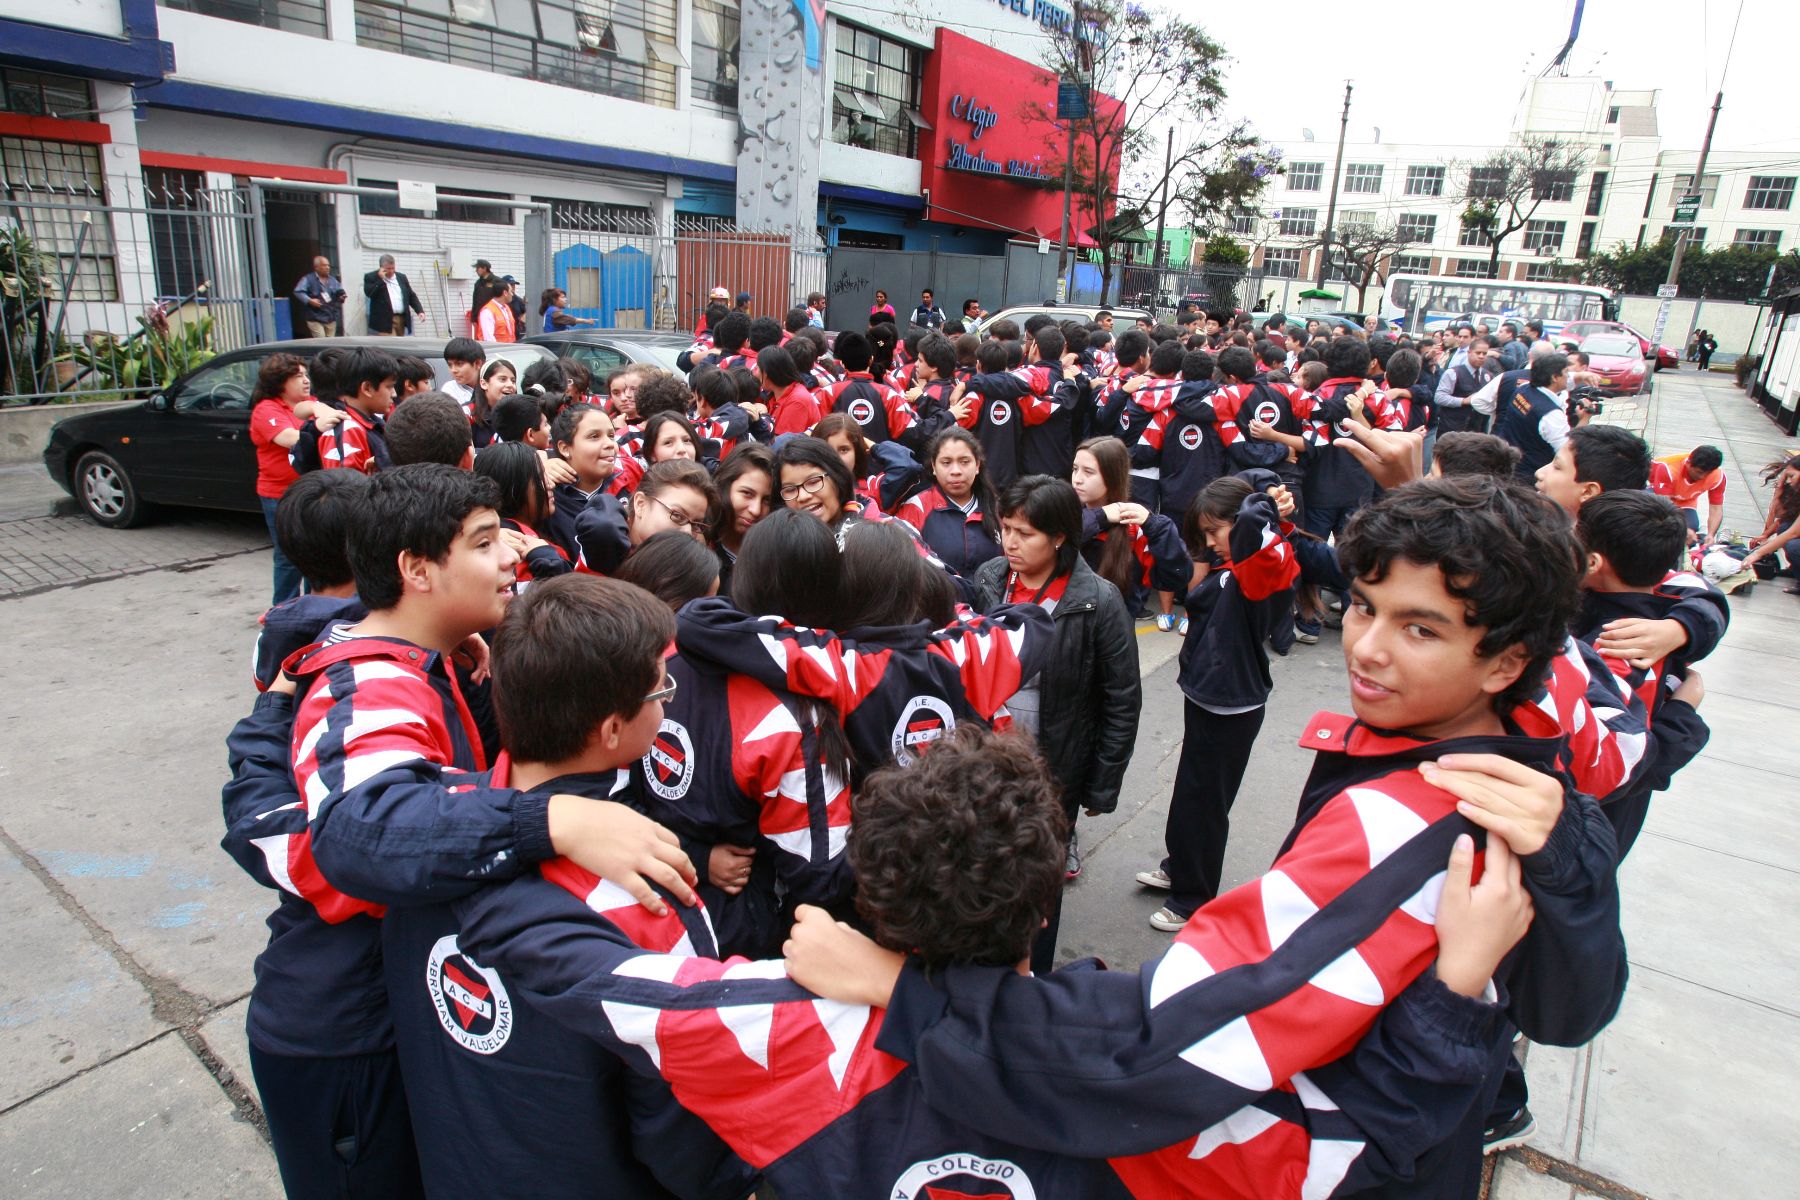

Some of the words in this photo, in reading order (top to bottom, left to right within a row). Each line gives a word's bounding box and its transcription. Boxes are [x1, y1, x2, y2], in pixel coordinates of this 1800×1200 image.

[656, 763, 693, 799] VALDELOMAR
[429, 956, 455, 1032] ABRAHAM
[459, 999, 511, 1051] VALDELOMAR
[926, 1157, 1015, 1180] COLEGIO
